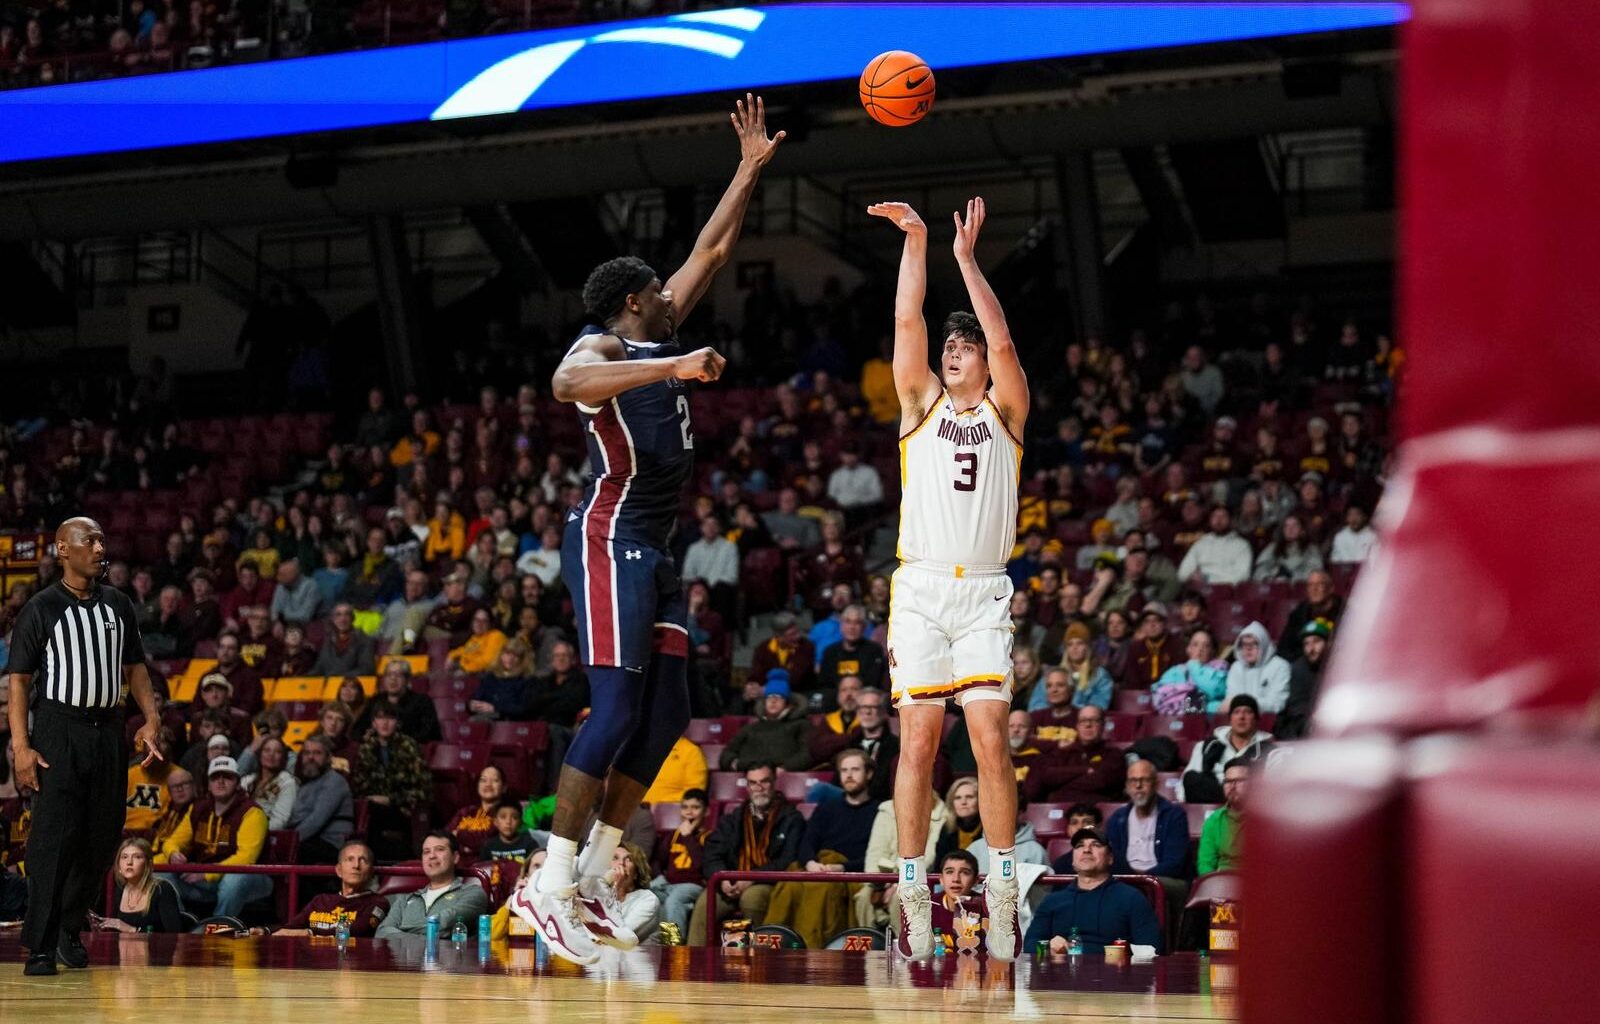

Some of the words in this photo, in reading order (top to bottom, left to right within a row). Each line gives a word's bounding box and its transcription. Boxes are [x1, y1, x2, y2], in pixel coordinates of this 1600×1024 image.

[676, 395, 693, 449] 2
[954, 453, 977, 491] 3
[127, 783, 161, 808] M
